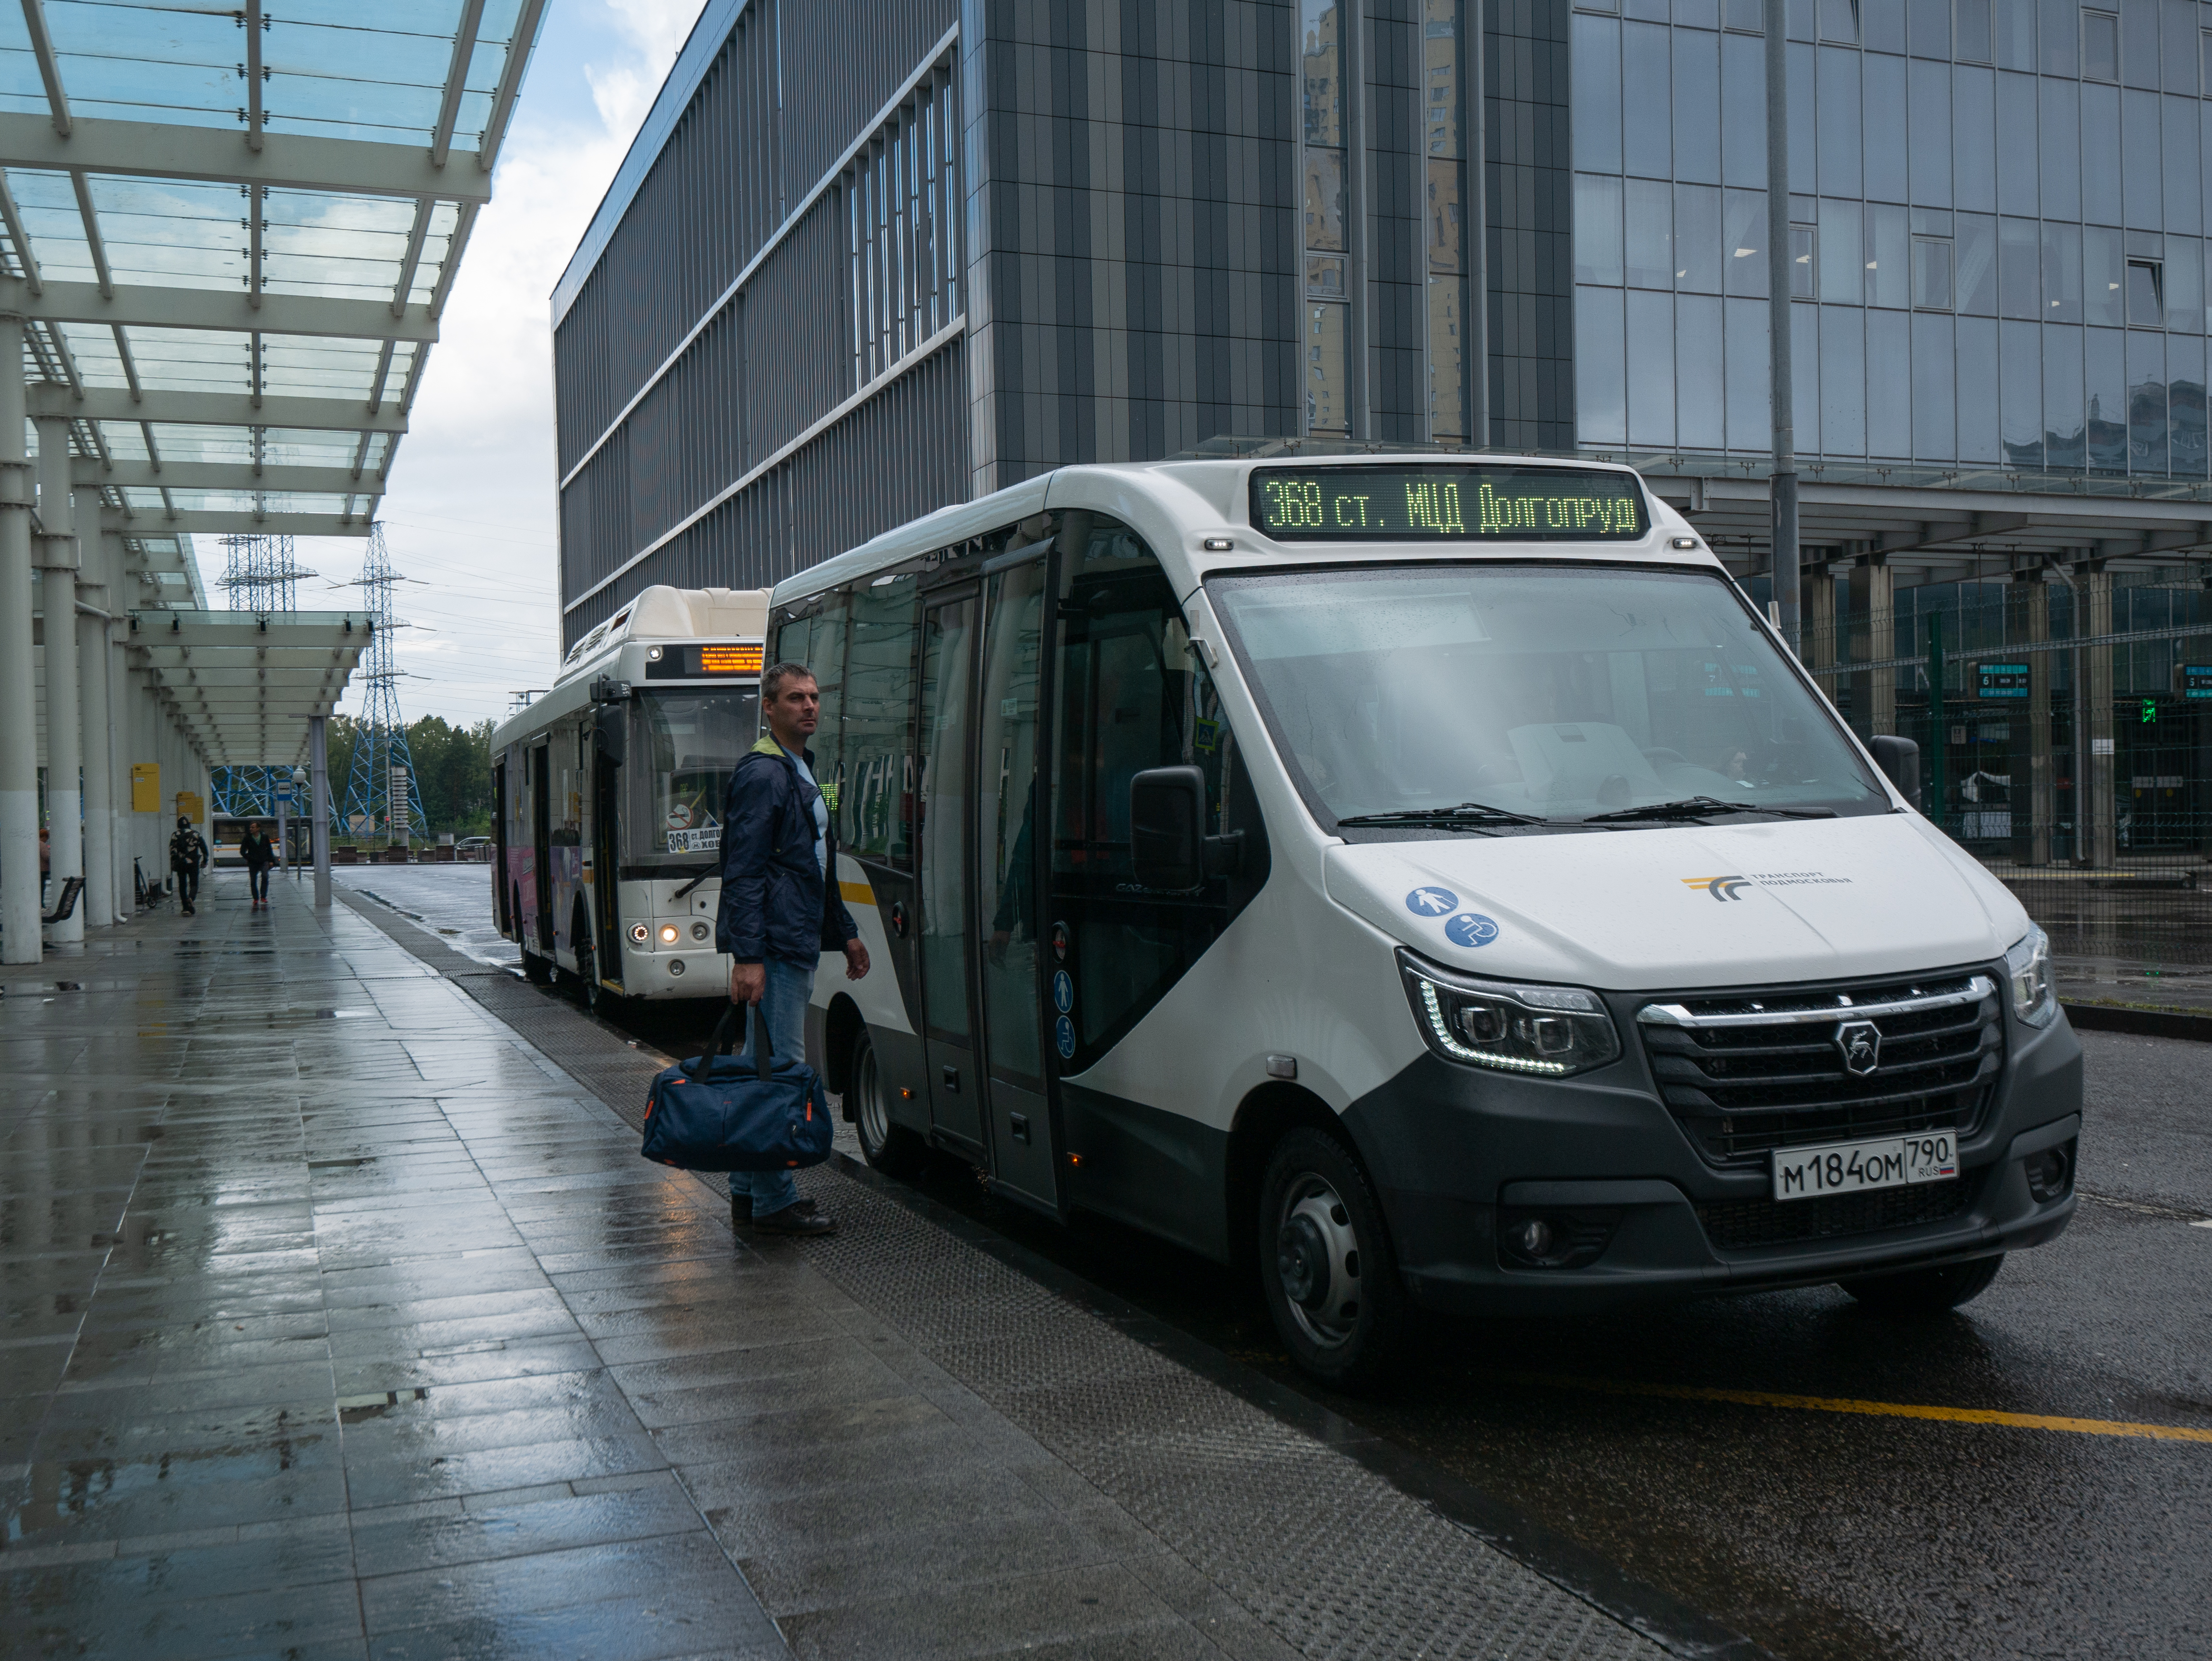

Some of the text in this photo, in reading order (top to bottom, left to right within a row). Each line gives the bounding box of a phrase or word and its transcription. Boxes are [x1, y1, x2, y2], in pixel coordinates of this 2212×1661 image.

[1265, 482, 1636, 533] 368 ст. МЦД Долгопруд
[1983, 676, 1989, 685] 6
[2189, 677, 2195, 686] 5
[669, 832, 690, 851] 368
[1907, 1137, 1949, 1168] 790
[1918, 1166, 1939, 1177] RUS
